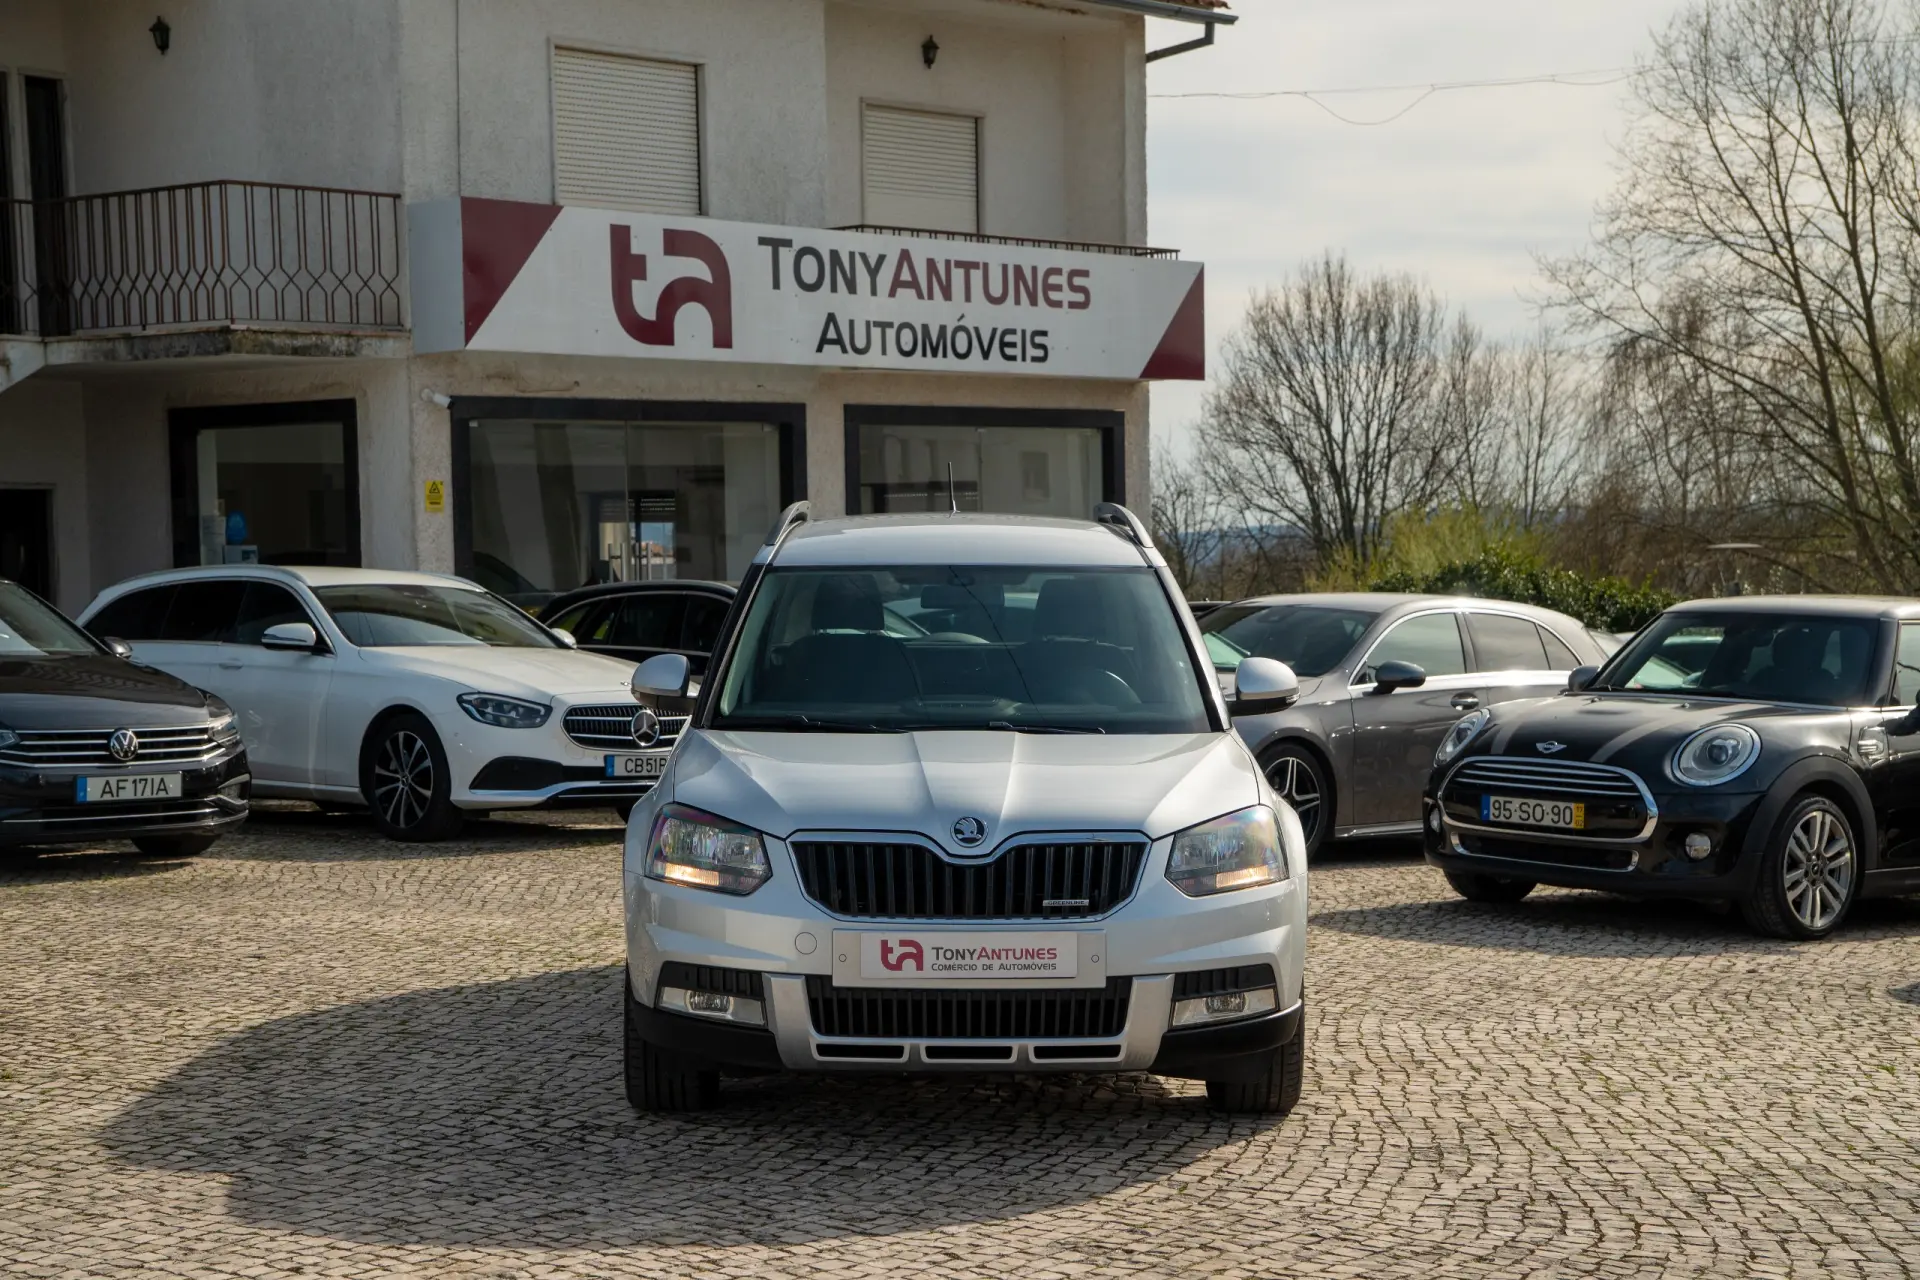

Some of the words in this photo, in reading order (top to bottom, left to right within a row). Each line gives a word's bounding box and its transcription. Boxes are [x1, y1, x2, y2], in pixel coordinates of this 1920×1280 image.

[815, 312, 1049, 363] AUTOMÓVEIS
[931, 962, 977, 972] COMÉRCIO
[982, 963, 994, 971] DE
[998, 962, 1057, 971] AUTOMÓVEIS
